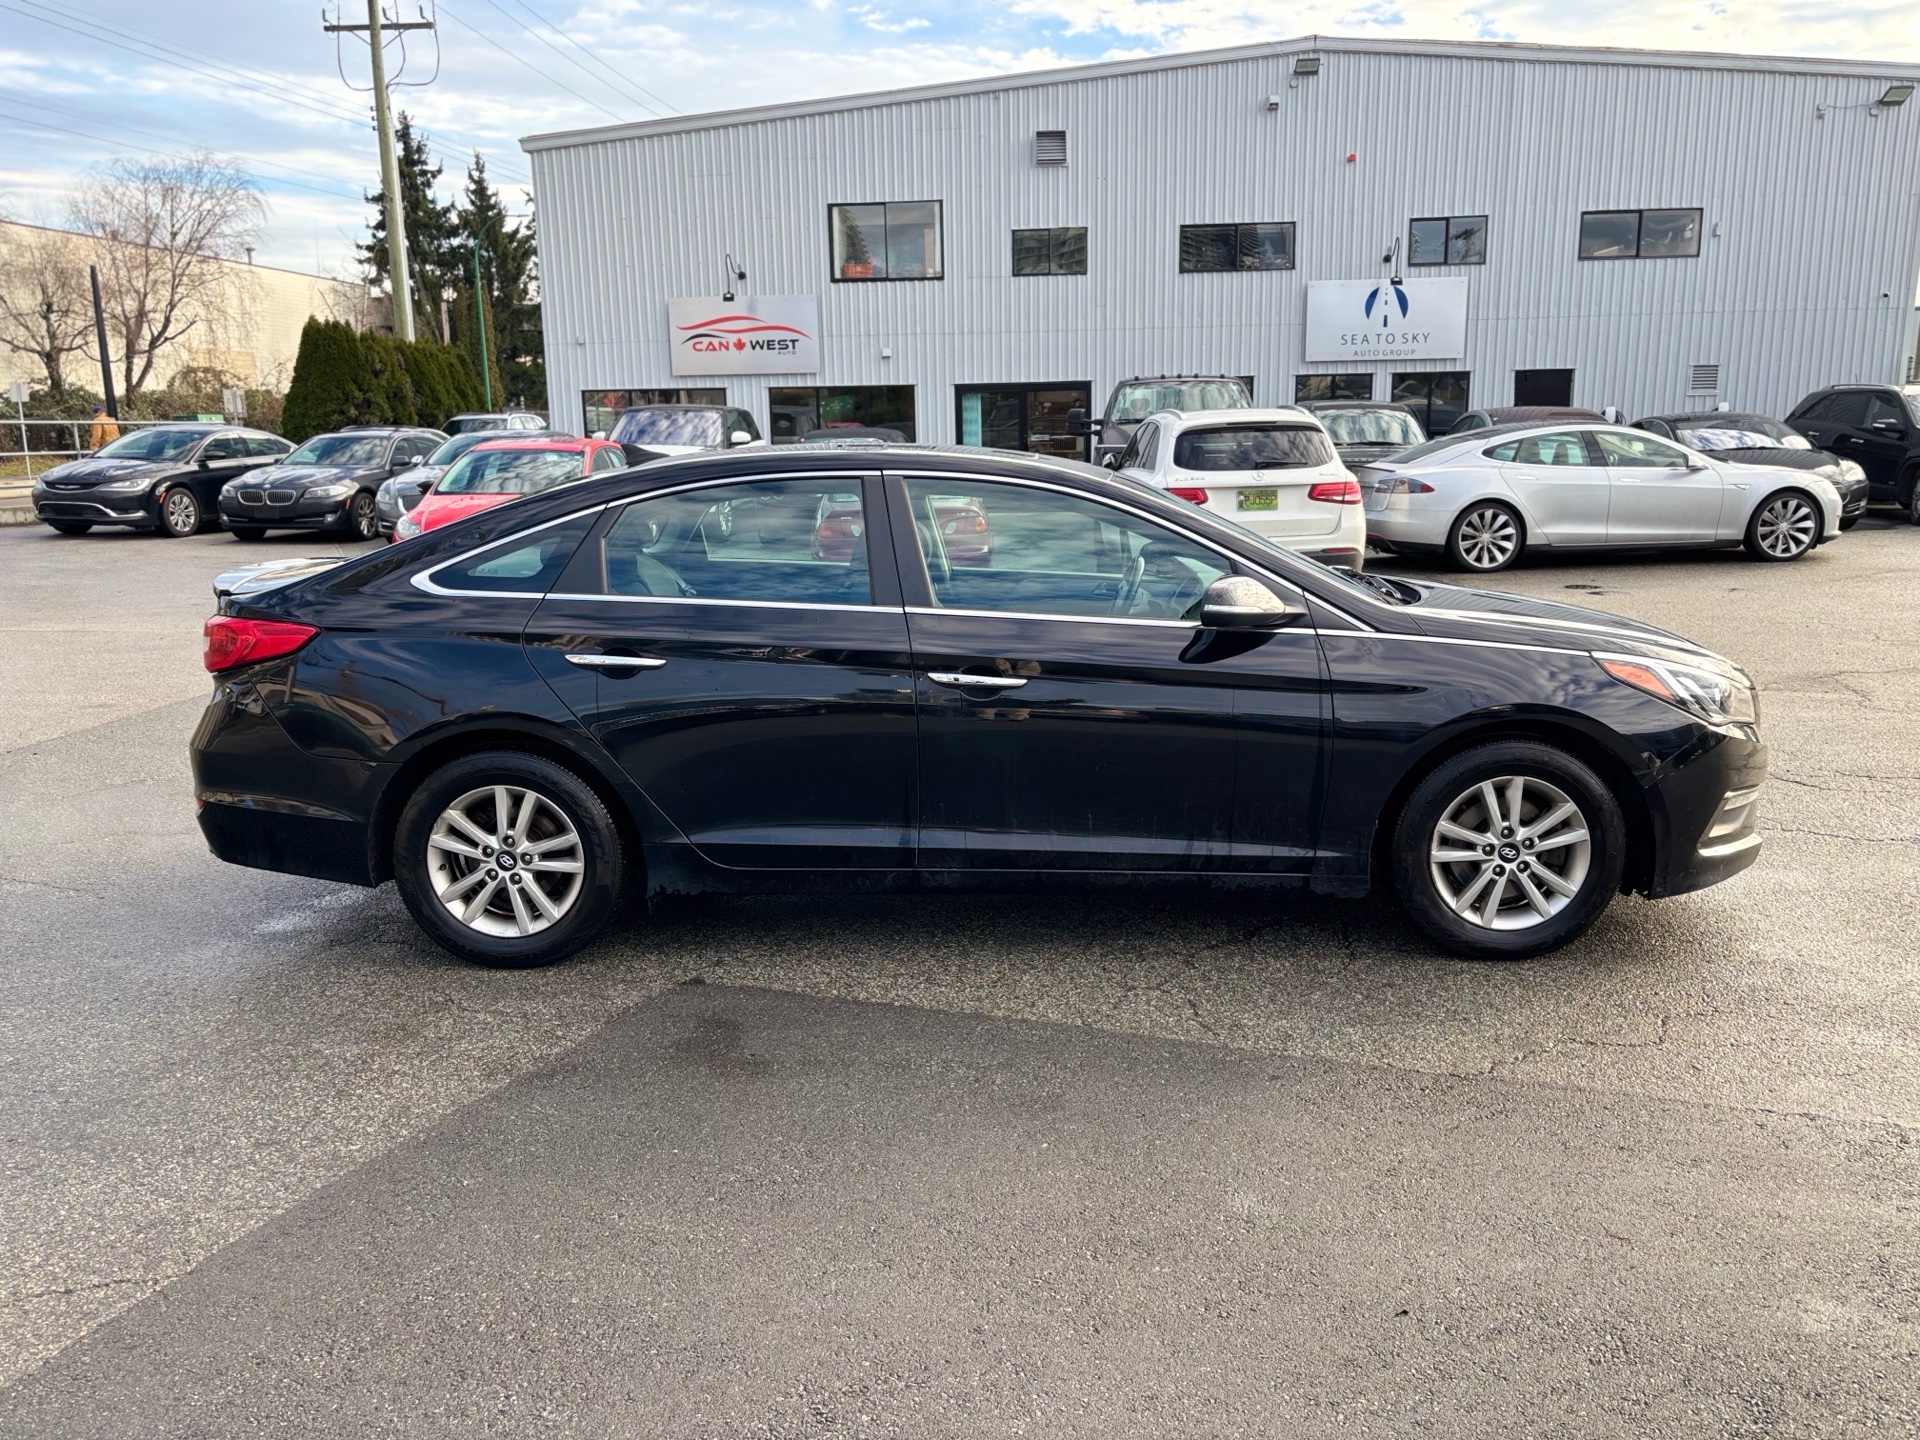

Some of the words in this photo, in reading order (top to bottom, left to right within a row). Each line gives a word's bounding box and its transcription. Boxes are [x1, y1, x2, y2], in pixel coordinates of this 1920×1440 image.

[692, 340, 730, 352] CAN
[750, 339, 800, 351] WEST
[1341, 333, 1370, 346] SEA
[1376, 333, 1396, 345] TO
[1402, 332, 1431, 344] SKY
[1353, 349, 1380, 357] AUTO
[1382, 348, 1416, 357] GROUP
